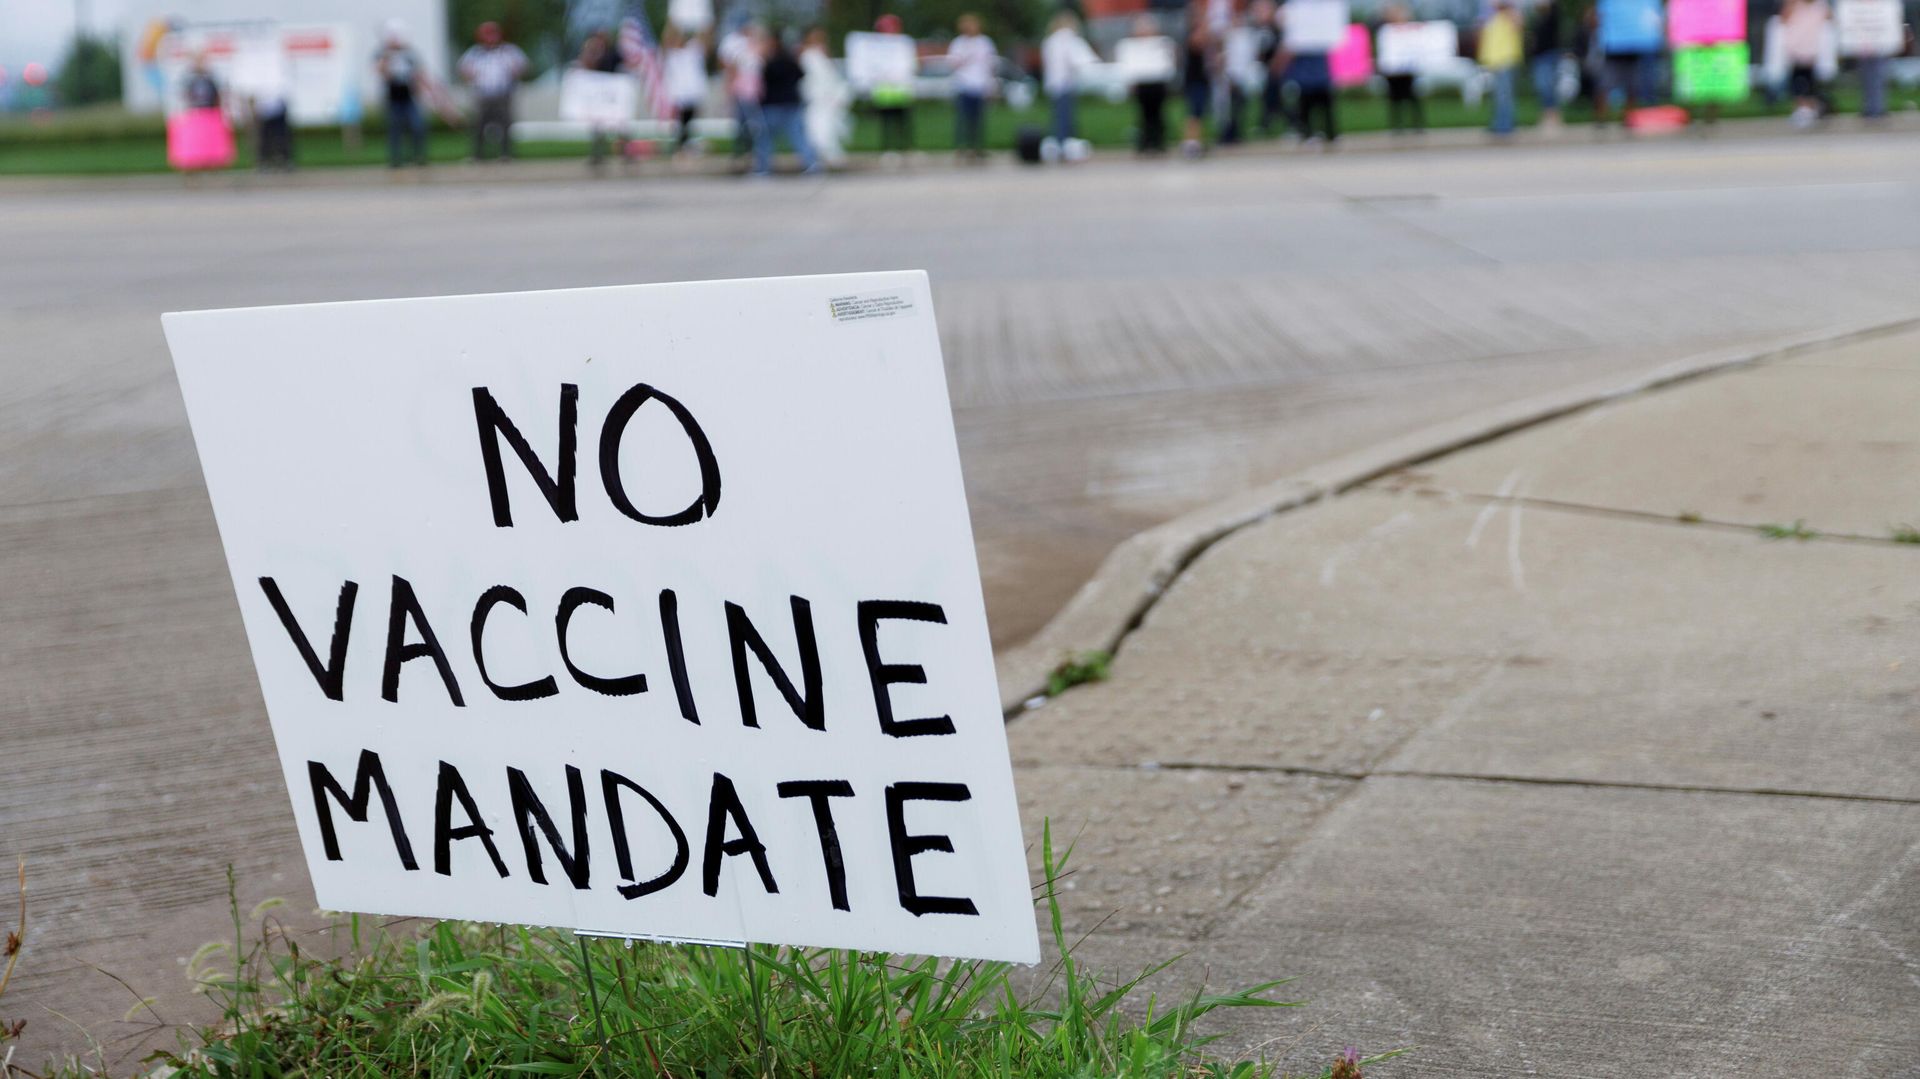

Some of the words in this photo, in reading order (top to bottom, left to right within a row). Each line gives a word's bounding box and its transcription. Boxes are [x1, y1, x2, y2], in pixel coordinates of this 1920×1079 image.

[472, 383, 722, 528] NO
[258, 574, 957, 738] VACCINE
[307, 748, 980, 917] MANDATE
